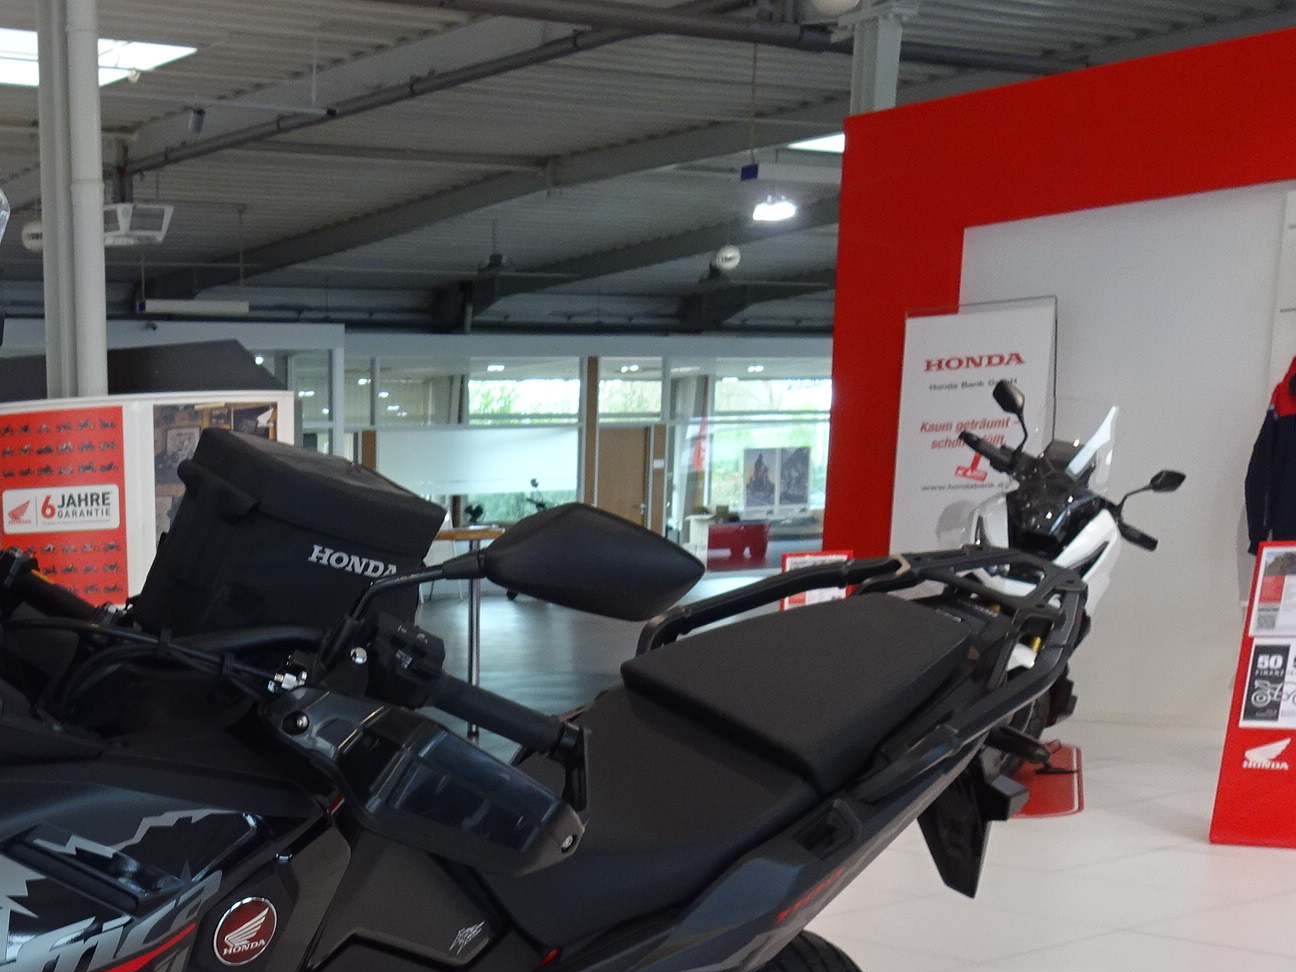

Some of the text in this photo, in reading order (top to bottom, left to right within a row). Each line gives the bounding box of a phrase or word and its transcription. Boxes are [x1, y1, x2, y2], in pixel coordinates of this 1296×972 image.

[924, 352, 1025, 372] HONDA
[929, 382, 958, 392] Honda
[920, 421, 953, 433] Kaum
[41, 491, 111, 519] 6 JAHRE
[57, 507, 111, 519] GARANTIE
[308, 544, 398, 579] HONDA
[1257, 654, 1283, 669] 50
[1242, 759, 1289, 771] HONDA
[222, 938, 266, 956] HONDA
